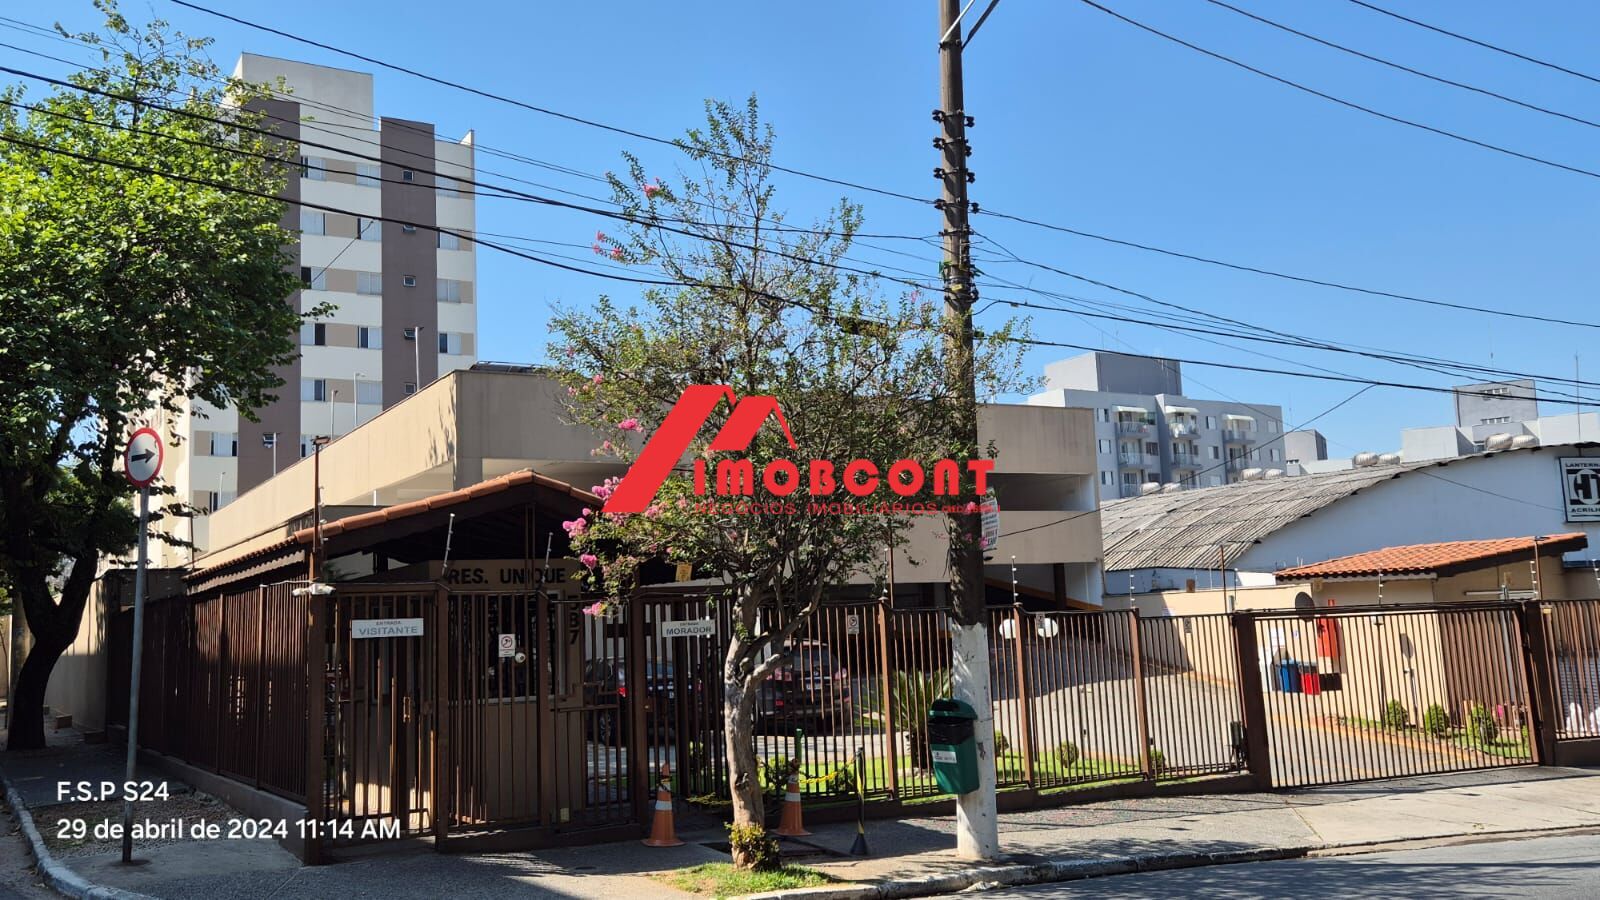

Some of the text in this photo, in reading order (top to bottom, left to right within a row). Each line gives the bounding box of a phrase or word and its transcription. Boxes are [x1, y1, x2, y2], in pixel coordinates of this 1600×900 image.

[448, 567, 566, 585] RES. UNIQUE
[359, 626, 418, 635] VISITANTE
[666, 626, 712, 636] MORADOR
